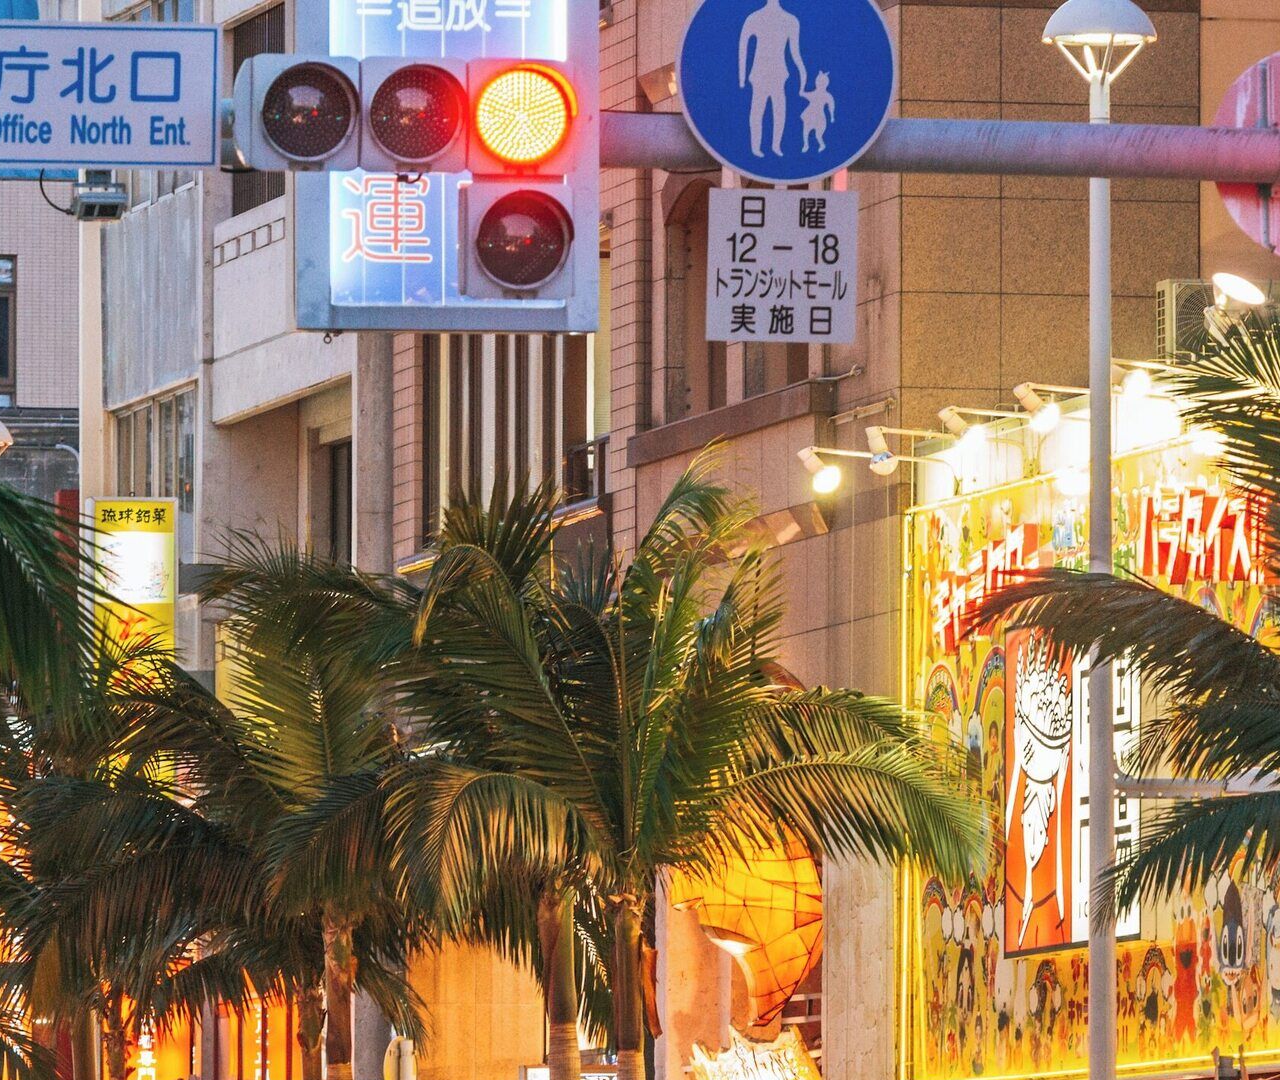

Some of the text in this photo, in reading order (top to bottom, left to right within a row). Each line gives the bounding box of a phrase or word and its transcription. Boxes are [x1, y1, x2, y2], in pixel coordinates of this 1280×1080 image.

[70, 115, 132, 145] North
[149, 116, 191, 146] Ent.
[740, 196, 827, 229] 日曜
[726, 233, 757, 263] 12
[808, 234, 839, 265] 18
[715, 267, 848, 300] トランジットモール
[729, 303, 832, 335] 実施日
